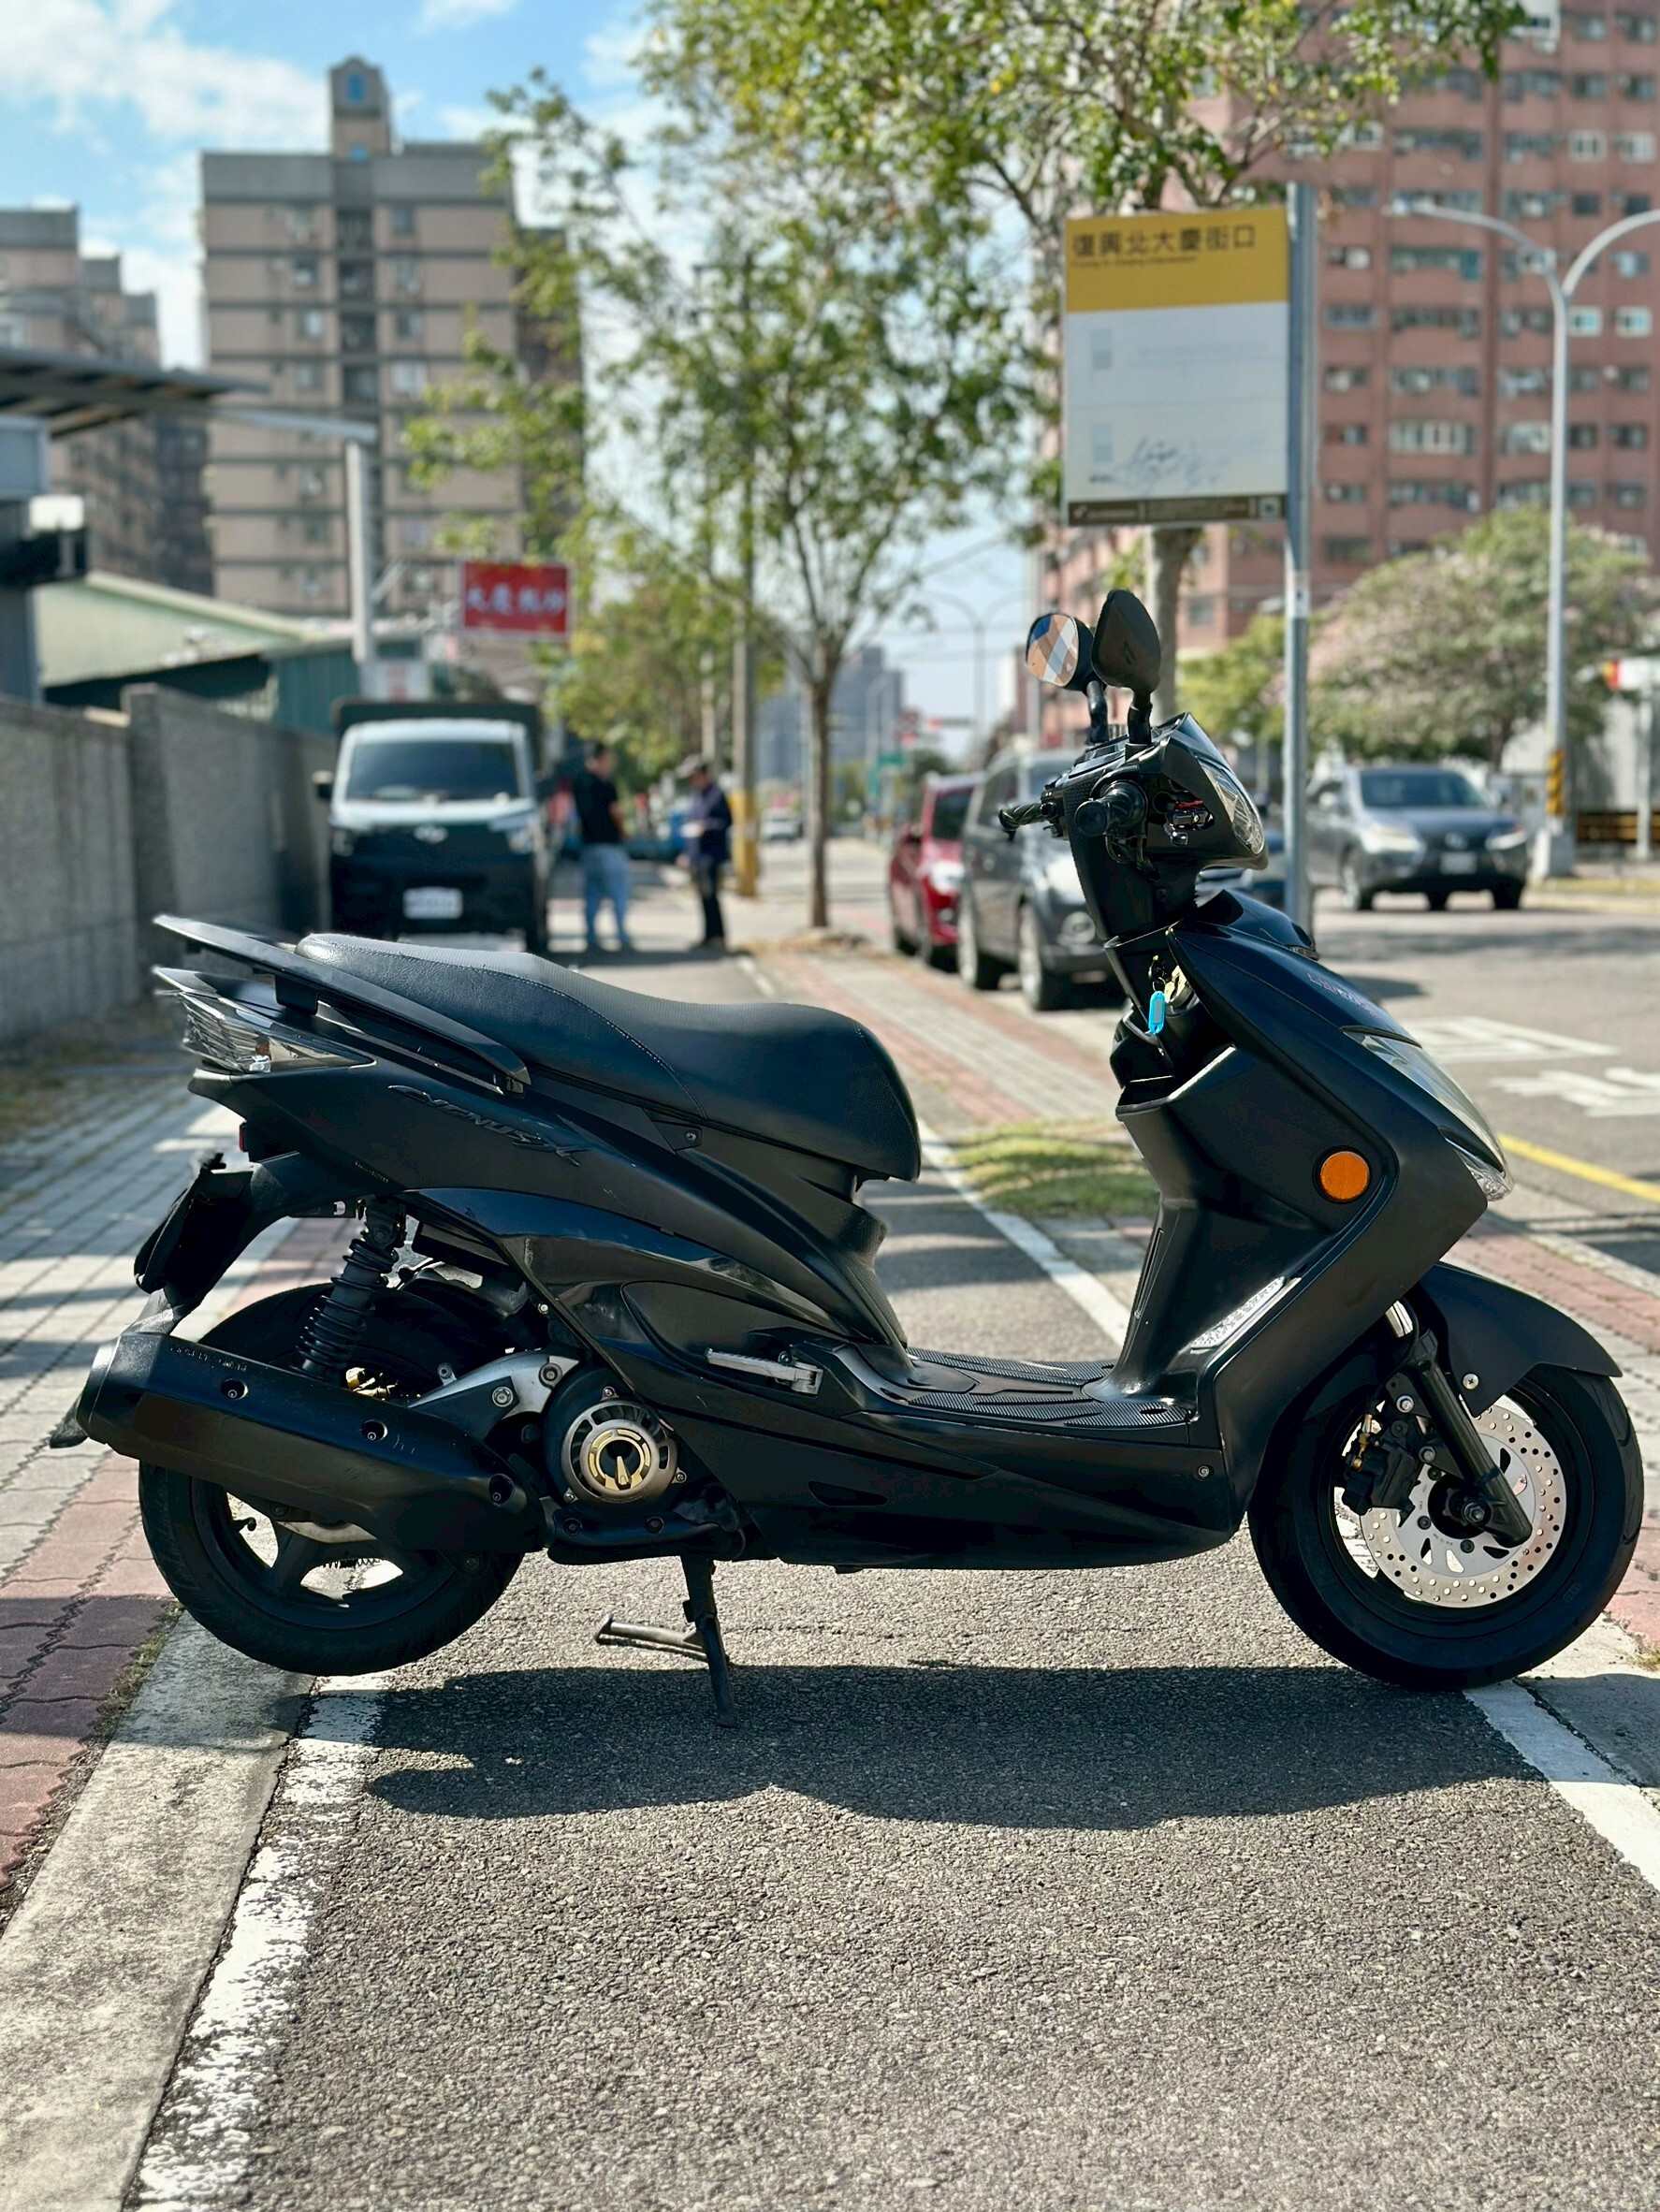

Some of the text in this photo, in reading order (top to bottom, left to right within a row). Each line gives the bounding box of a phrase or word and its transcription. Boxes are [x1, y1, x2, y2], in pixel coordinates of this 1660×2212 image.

[1072, 225, 1256, 257] 復興北大慶街口
